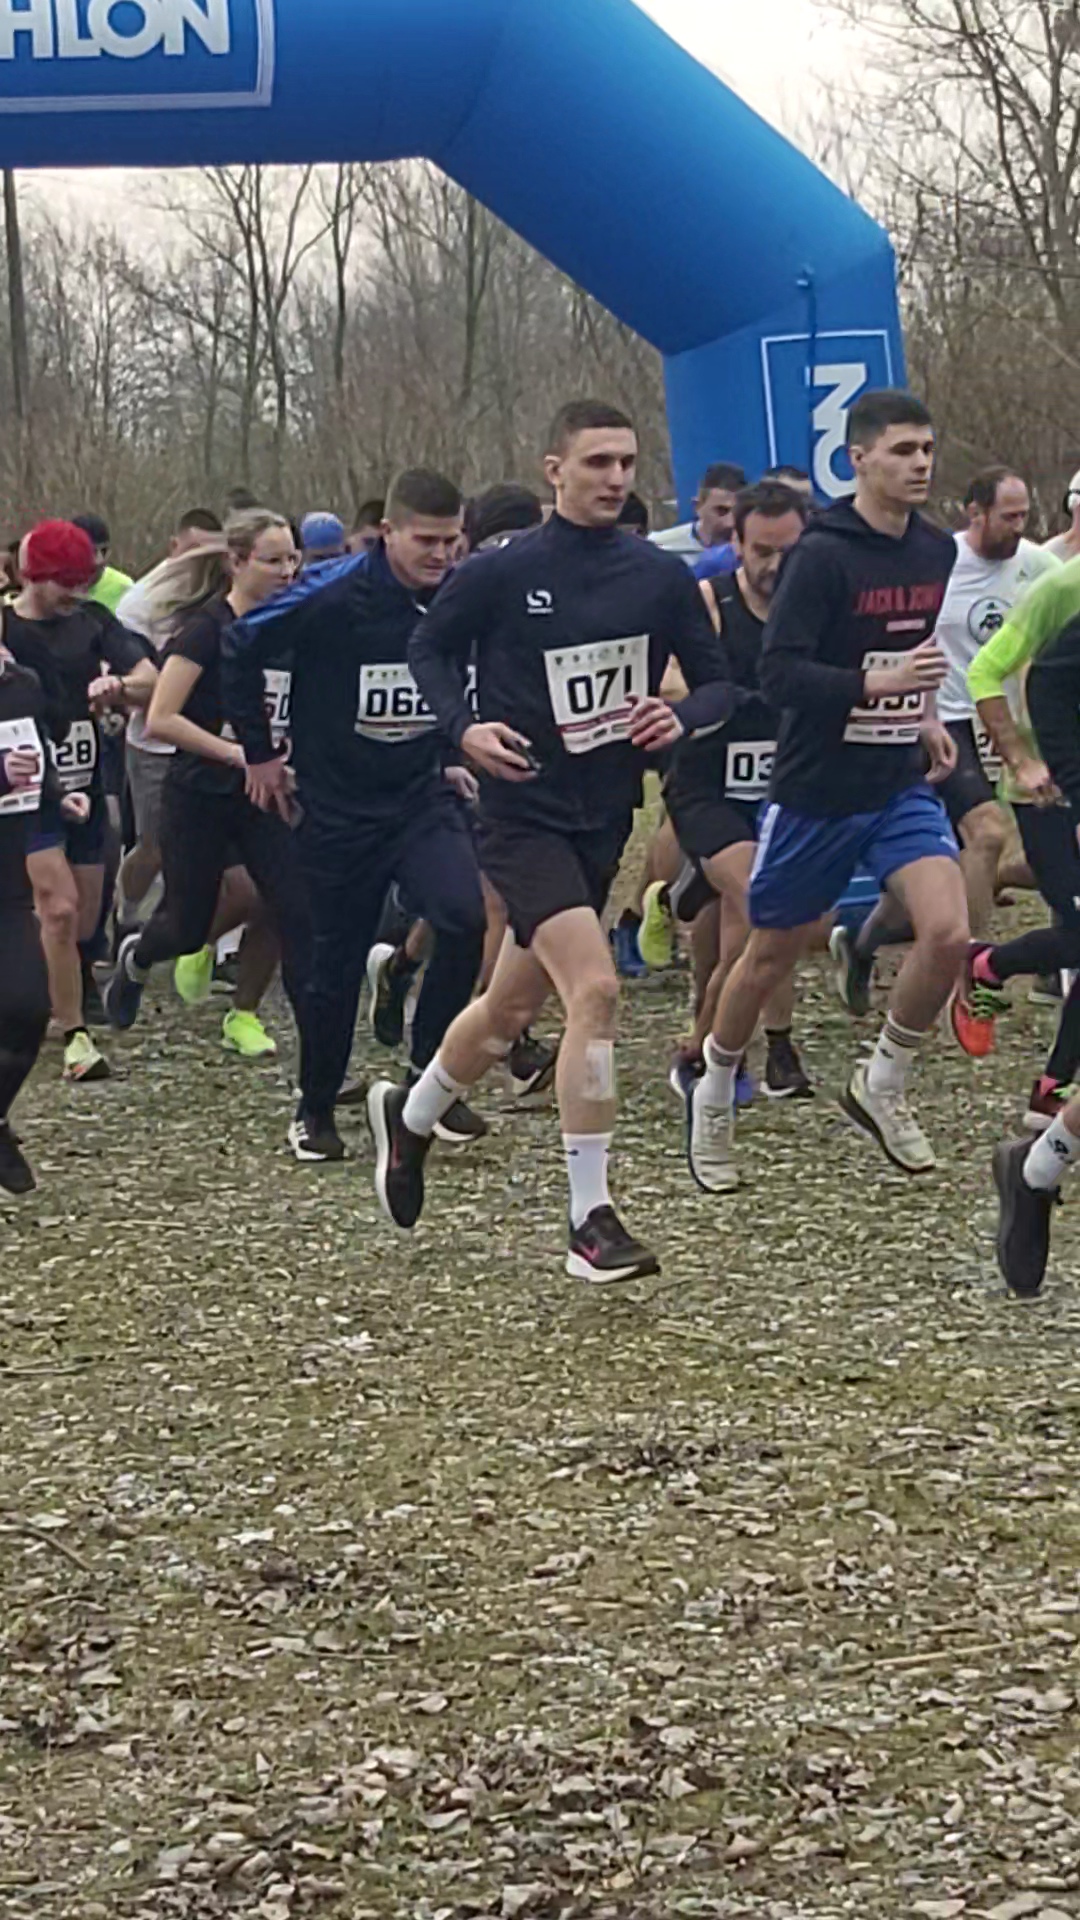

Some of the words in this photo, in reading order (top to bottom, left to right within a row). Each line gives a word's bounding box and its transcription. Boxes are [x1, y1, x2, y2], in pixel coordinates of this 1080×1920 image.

[0, 0, 230, 59] HLON
[567, 664, 632, 714] 071
[56, 739, 92, 766] 28
